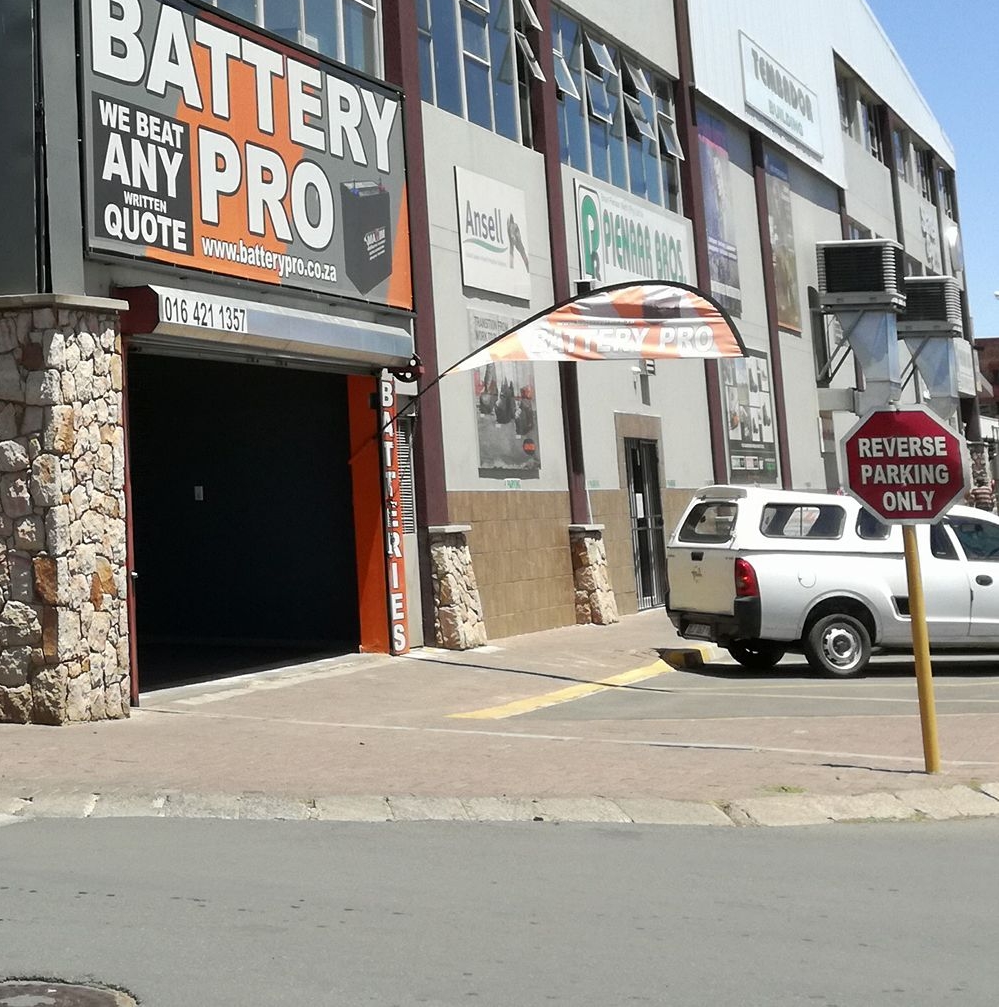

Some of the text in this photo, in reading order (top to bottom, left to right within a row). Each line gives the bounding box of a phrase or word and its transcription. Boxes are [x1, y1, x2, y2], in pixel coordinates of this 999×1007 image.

[98, 99, 185, 149] WE BEAT
[101, 132, 184, 199] ANY
[197, 126, 336, 251] PRO
[123, 190, 168, 214] WRITTEN
[465, 199, 504, 245] Ansell
[104, 203, 188, 252] QUOTE
[201, 235, 338, 283] www.batterypro.co.za
[164, 295, 247, 332] 016 421 1357
[658, 324, 714, 352] PRO
[857, 436, 948, 459] REVERSE
[860, 464, 950, 486] PARKING
[381, 380, 407, 653] BATTERIES
[882, 490, 936, 512] ONLY
